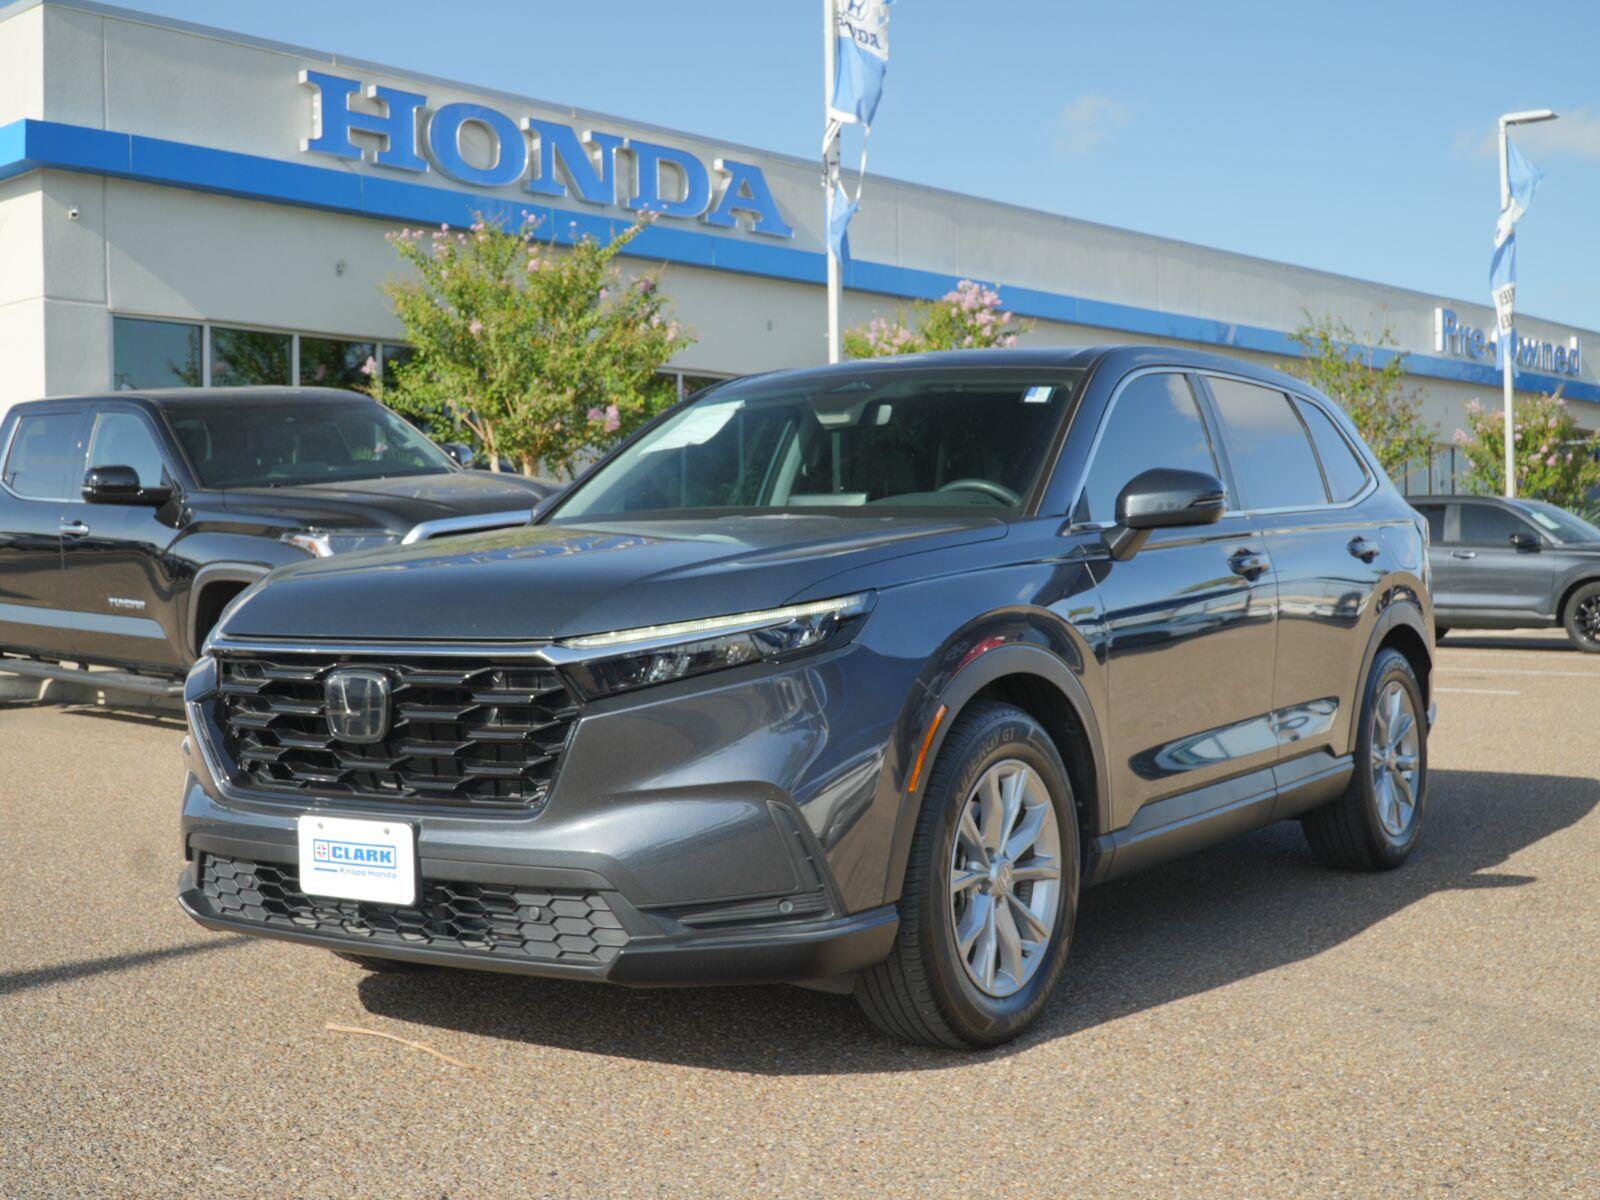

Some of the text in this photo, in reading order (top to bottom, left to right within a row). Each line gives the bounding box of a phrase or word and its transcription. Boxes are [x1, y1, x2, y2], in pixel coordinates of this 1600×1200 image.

[299, 69, 794, 239] HONDA
[332, 846, 392, 863] CLARK
[339, 866, 397, 879] Knapp Honda
